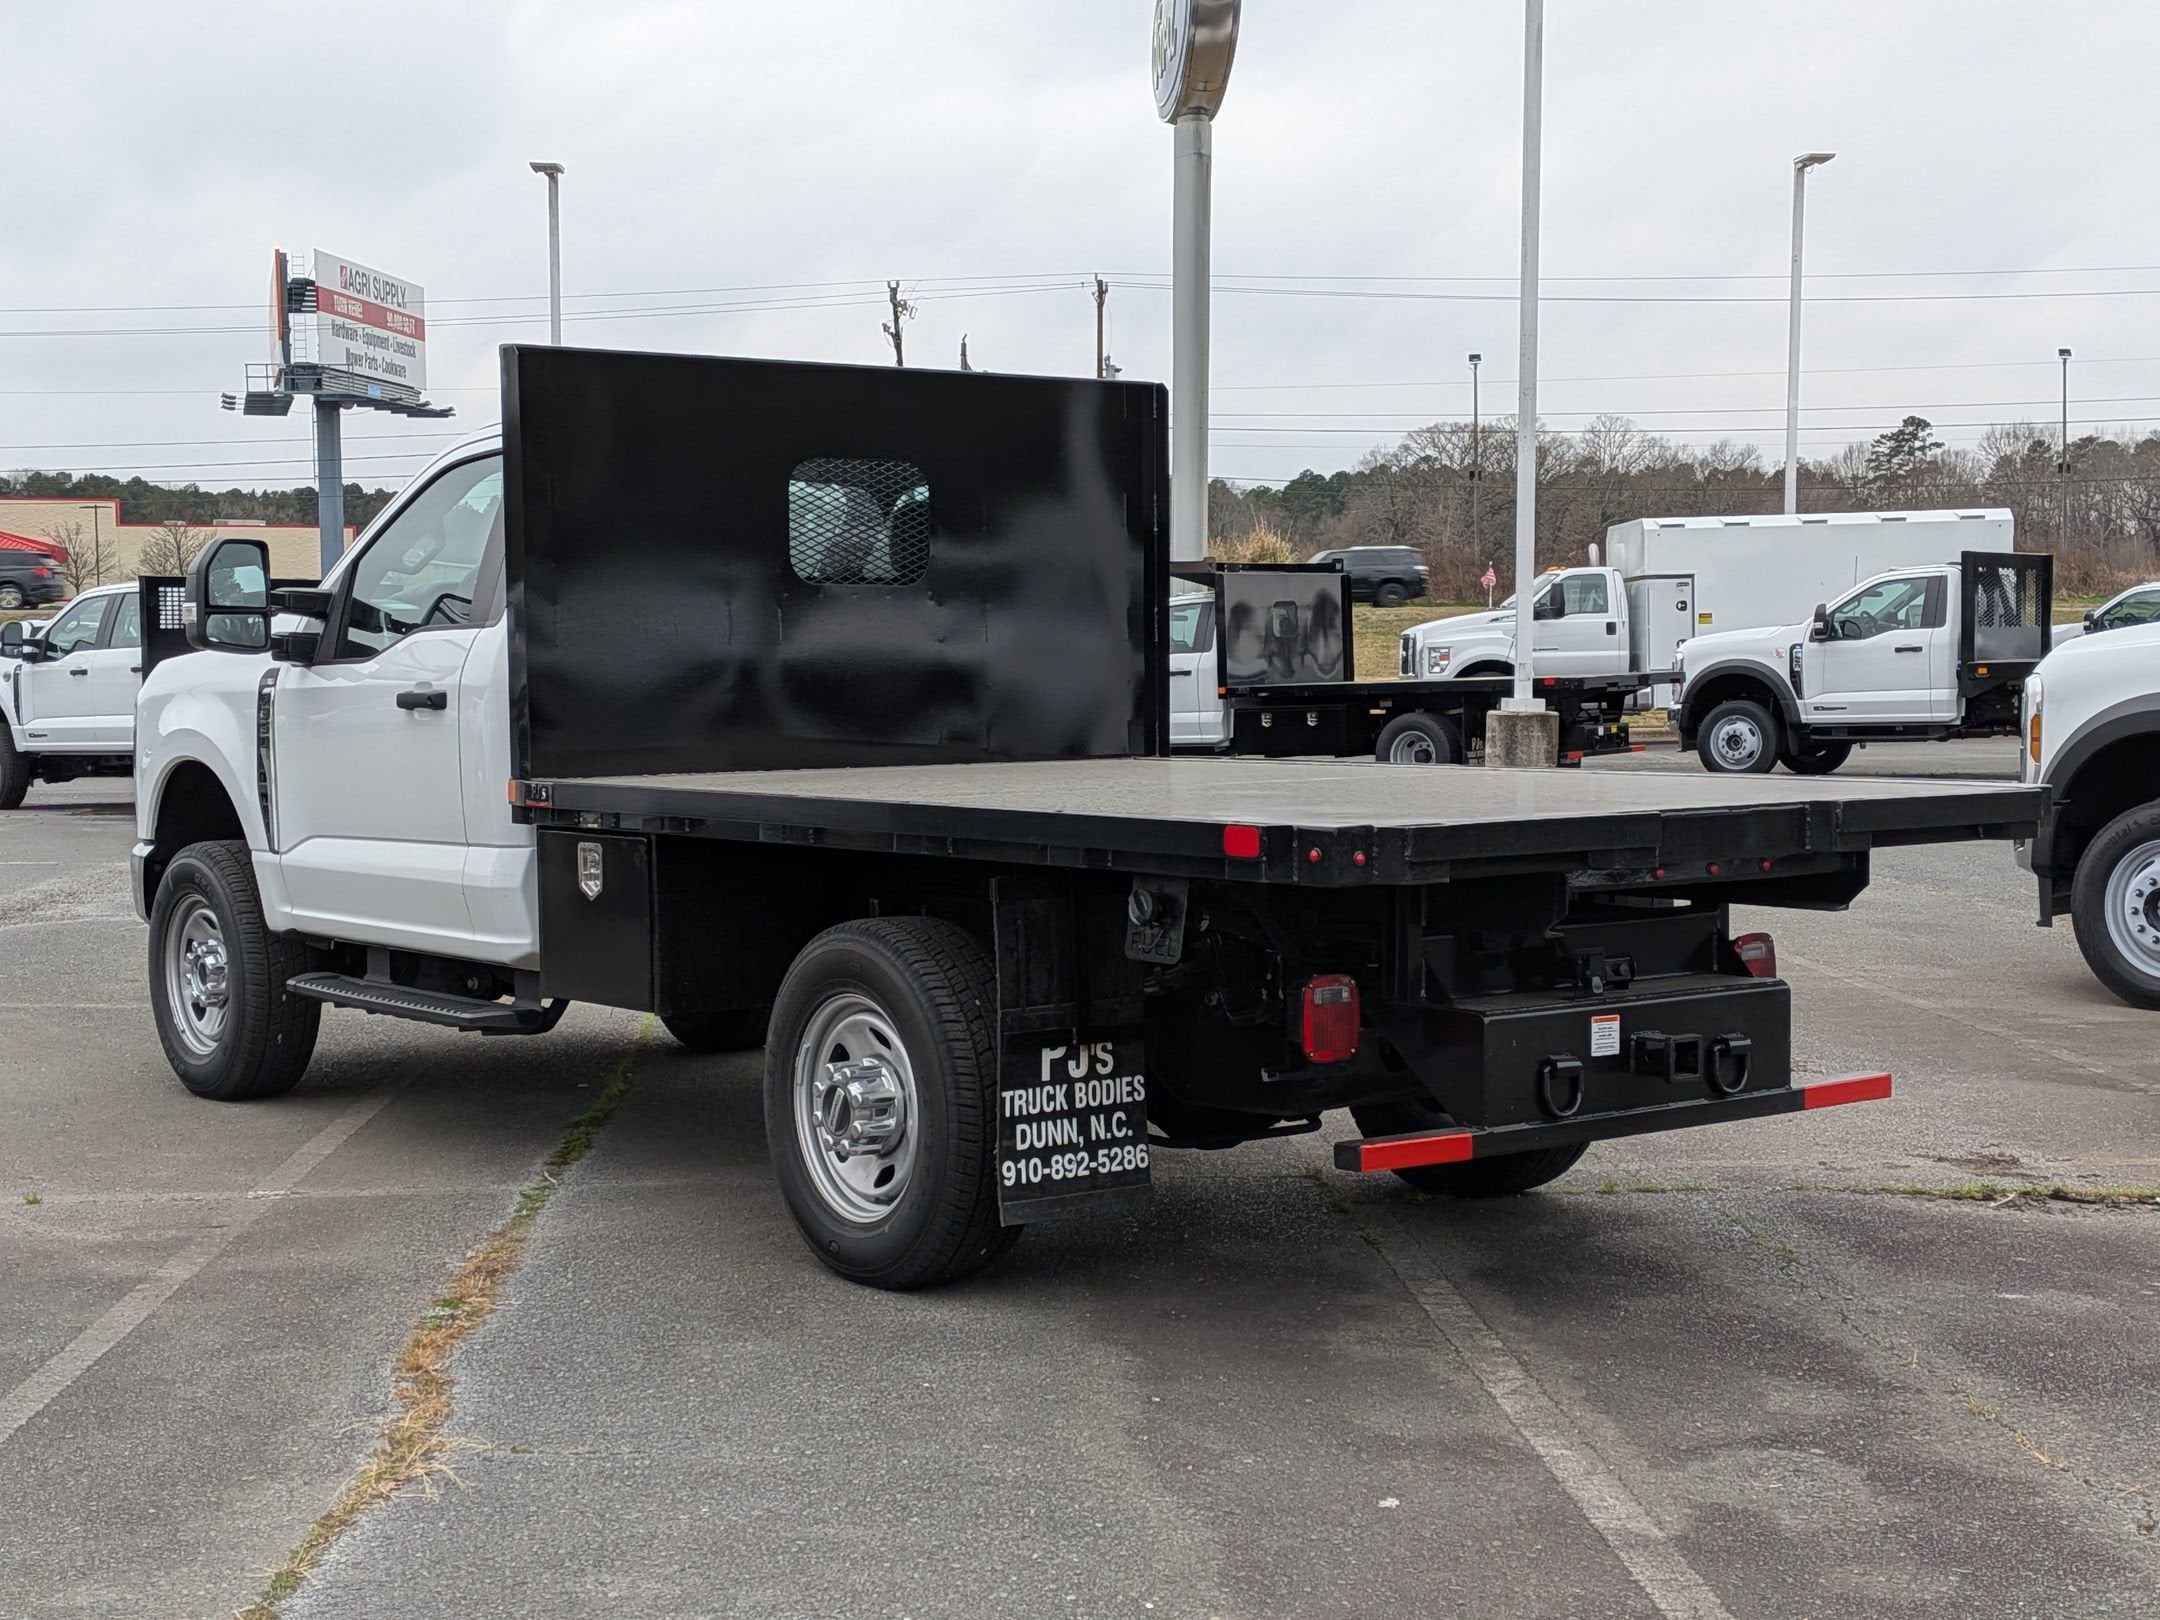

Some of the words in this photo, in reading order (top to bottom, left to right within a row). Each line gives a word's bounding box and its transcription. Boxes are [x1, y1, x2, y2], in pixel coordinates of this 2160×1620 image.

[349, 267, 370, 298] AGRI
[331, 319, 358, 342] Hardware
[362, 327, 390, 352] Equipment
[393, 336, 416, 358] Livestock
[364, 351, 378, 371] Parts
[382, 356, 406, 378] Cookware
[1002, 1084, 1068, 1118] TRUCK
[1074, 1074, 1146, 1109] BODIES
[1015, 1117, 1084, 1150] DUNN,
[1090, 1111, 1133, 1142] N.C.
[1001, 1143, 1149, 1187] 910-892-5286
